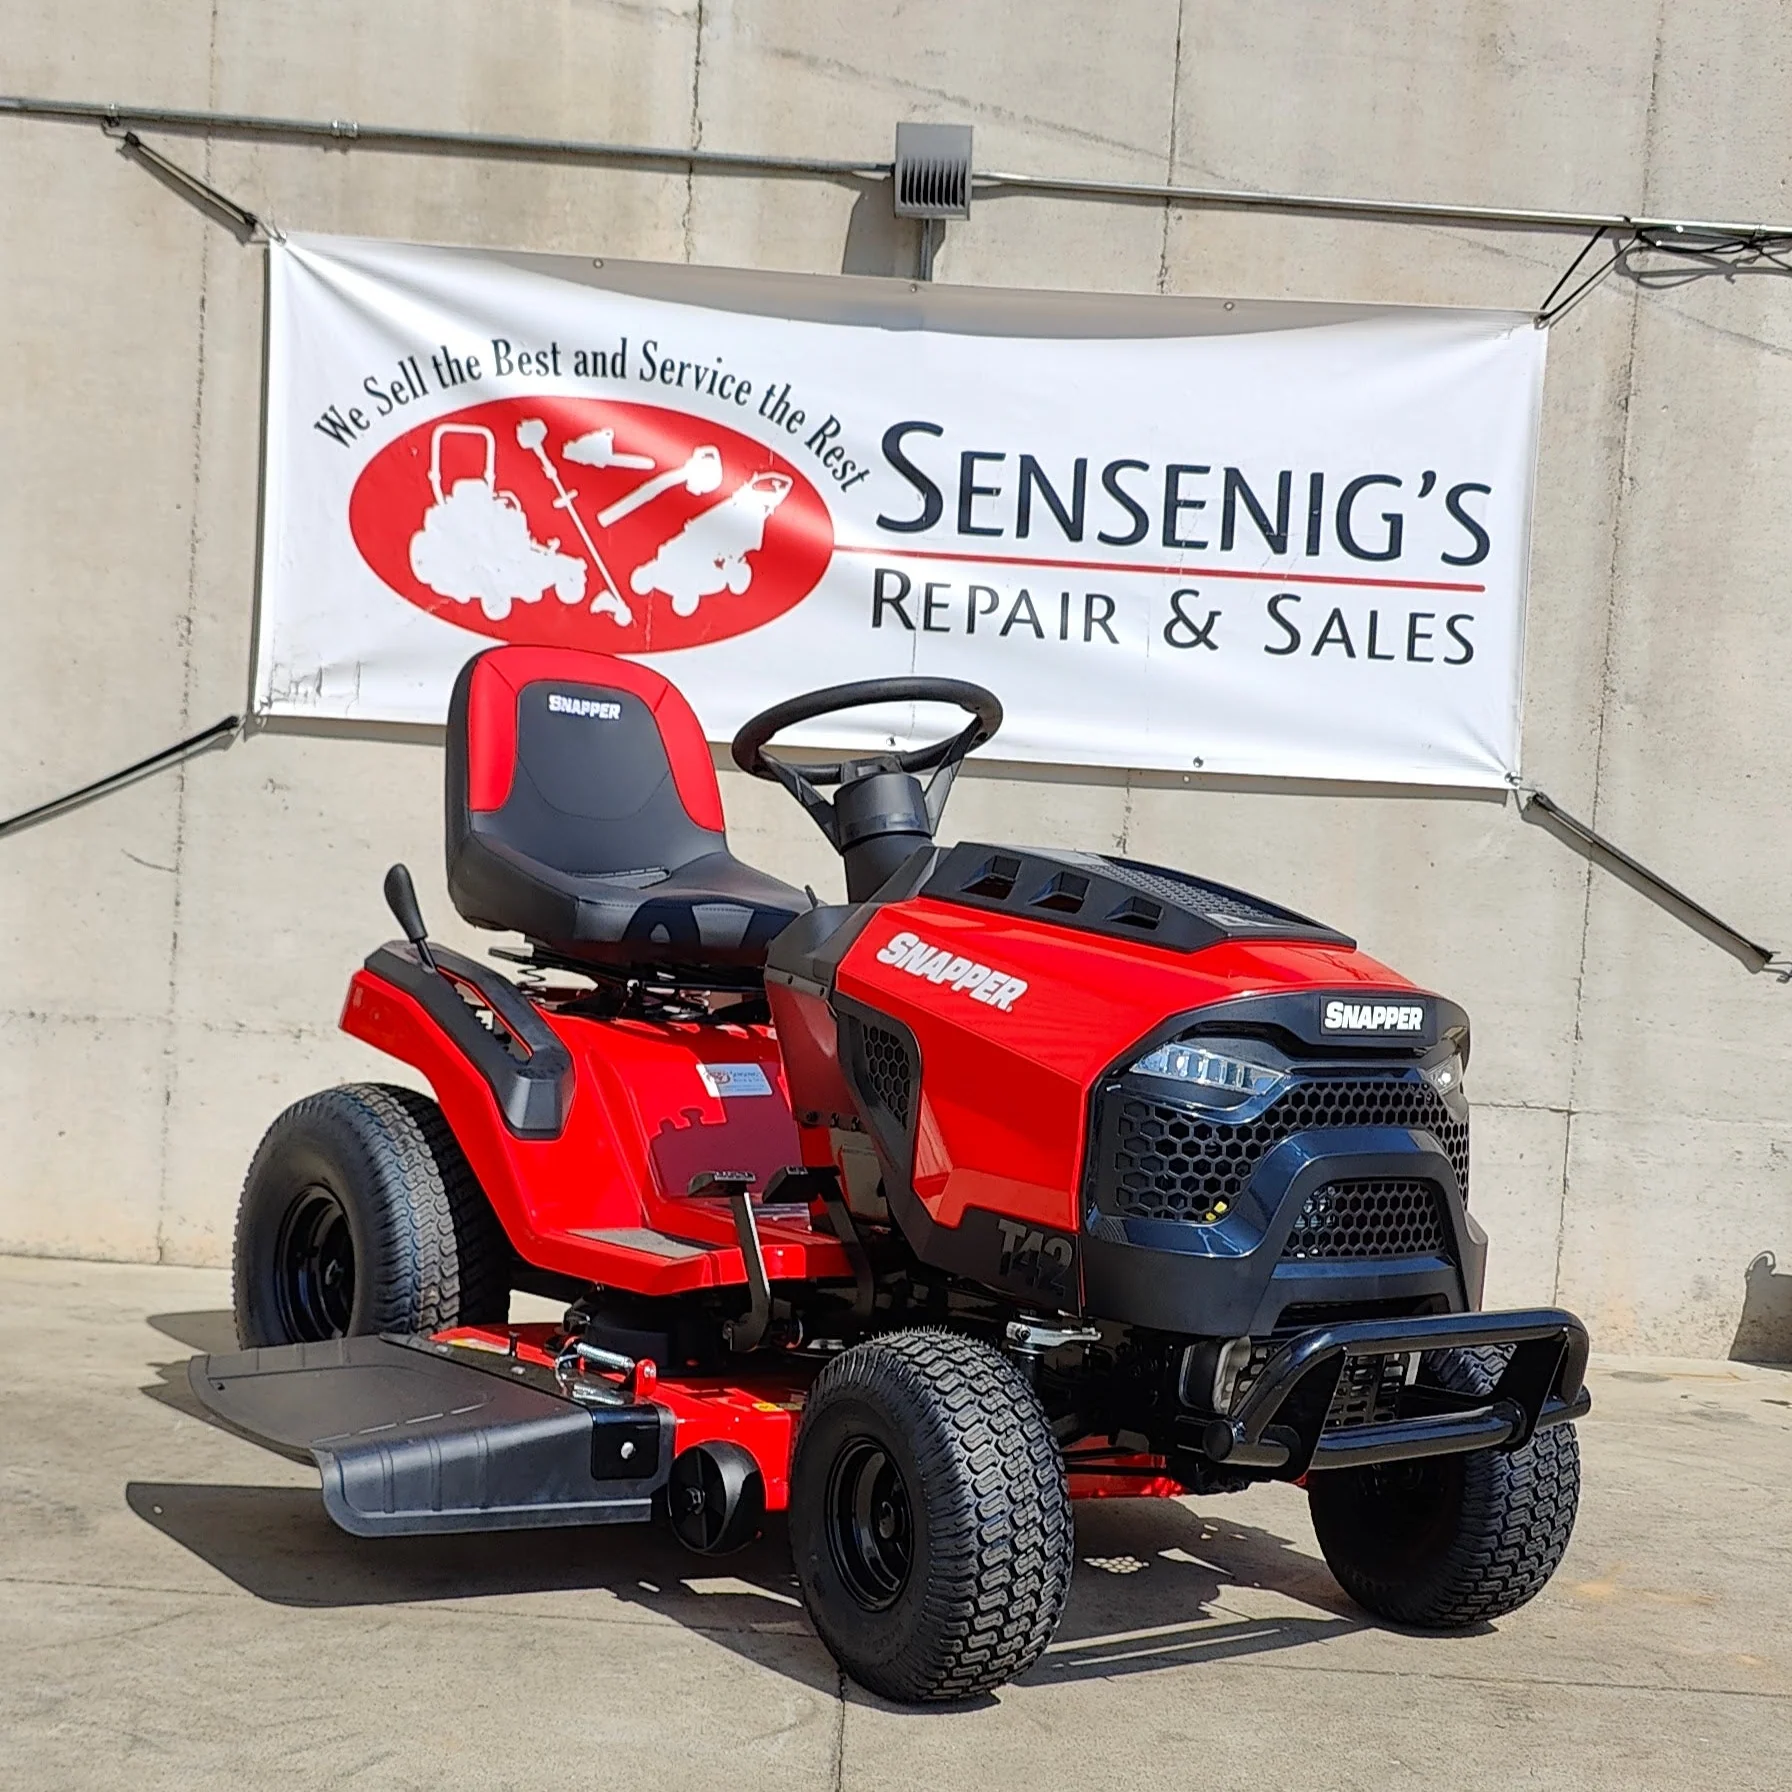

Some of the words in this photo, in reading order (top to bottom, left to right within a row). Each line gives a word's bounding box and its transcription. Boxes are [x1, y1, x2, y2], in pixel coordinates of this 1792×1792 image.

[314, 405, 371, 450] We
[363, 358, 429, 418] Sell
[433, 345, 482, 390] the
[493, 338, 561, 378] Best
[573, 337, 627, 379] and
[638, 340, 753, 406] Service
[758, 383, 807, 435] the
[804, 415, 871, 493] Rest
[876, 421, 1492, 567] SENSENIG'S
[872, 568, 1119, 644] REPAIR
[1163, 589, 1222, 651] &
[1264, 593, 1475, 666] SALES
[549, 694, 621, 720] SNAPPER
[876, 932, 1028, 1012] SNAPPER
[1324, 1001, 1423, 1030] SNAPPER
[998, 1218, 1072, 1299] T42
